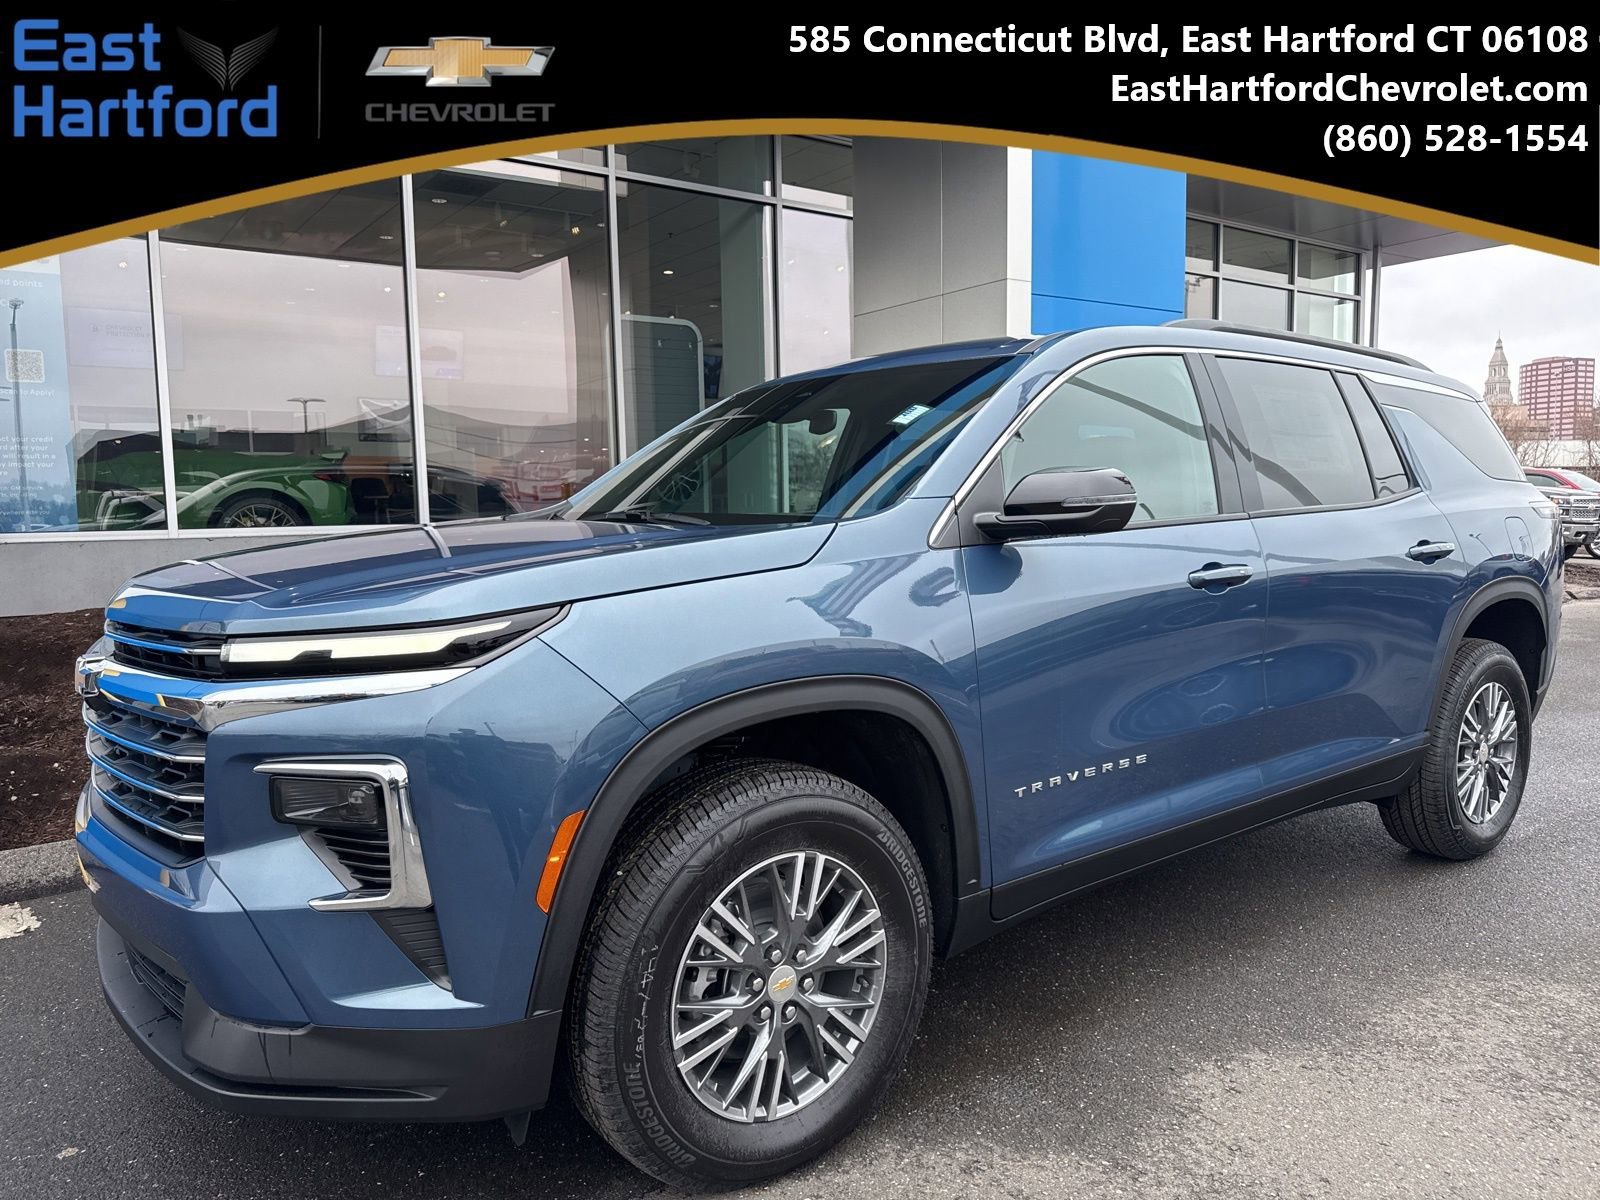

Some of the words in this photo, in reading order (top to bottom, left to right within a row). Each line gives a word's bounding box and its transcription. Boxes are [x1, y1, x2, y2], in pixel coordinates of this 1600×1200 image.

[1014, 753, 1148, 798] TRAVERSE
[877, 828, 929, 929] BRIDGESTONE
[623, 1061, 697, 1167] BRIDGESTONE
